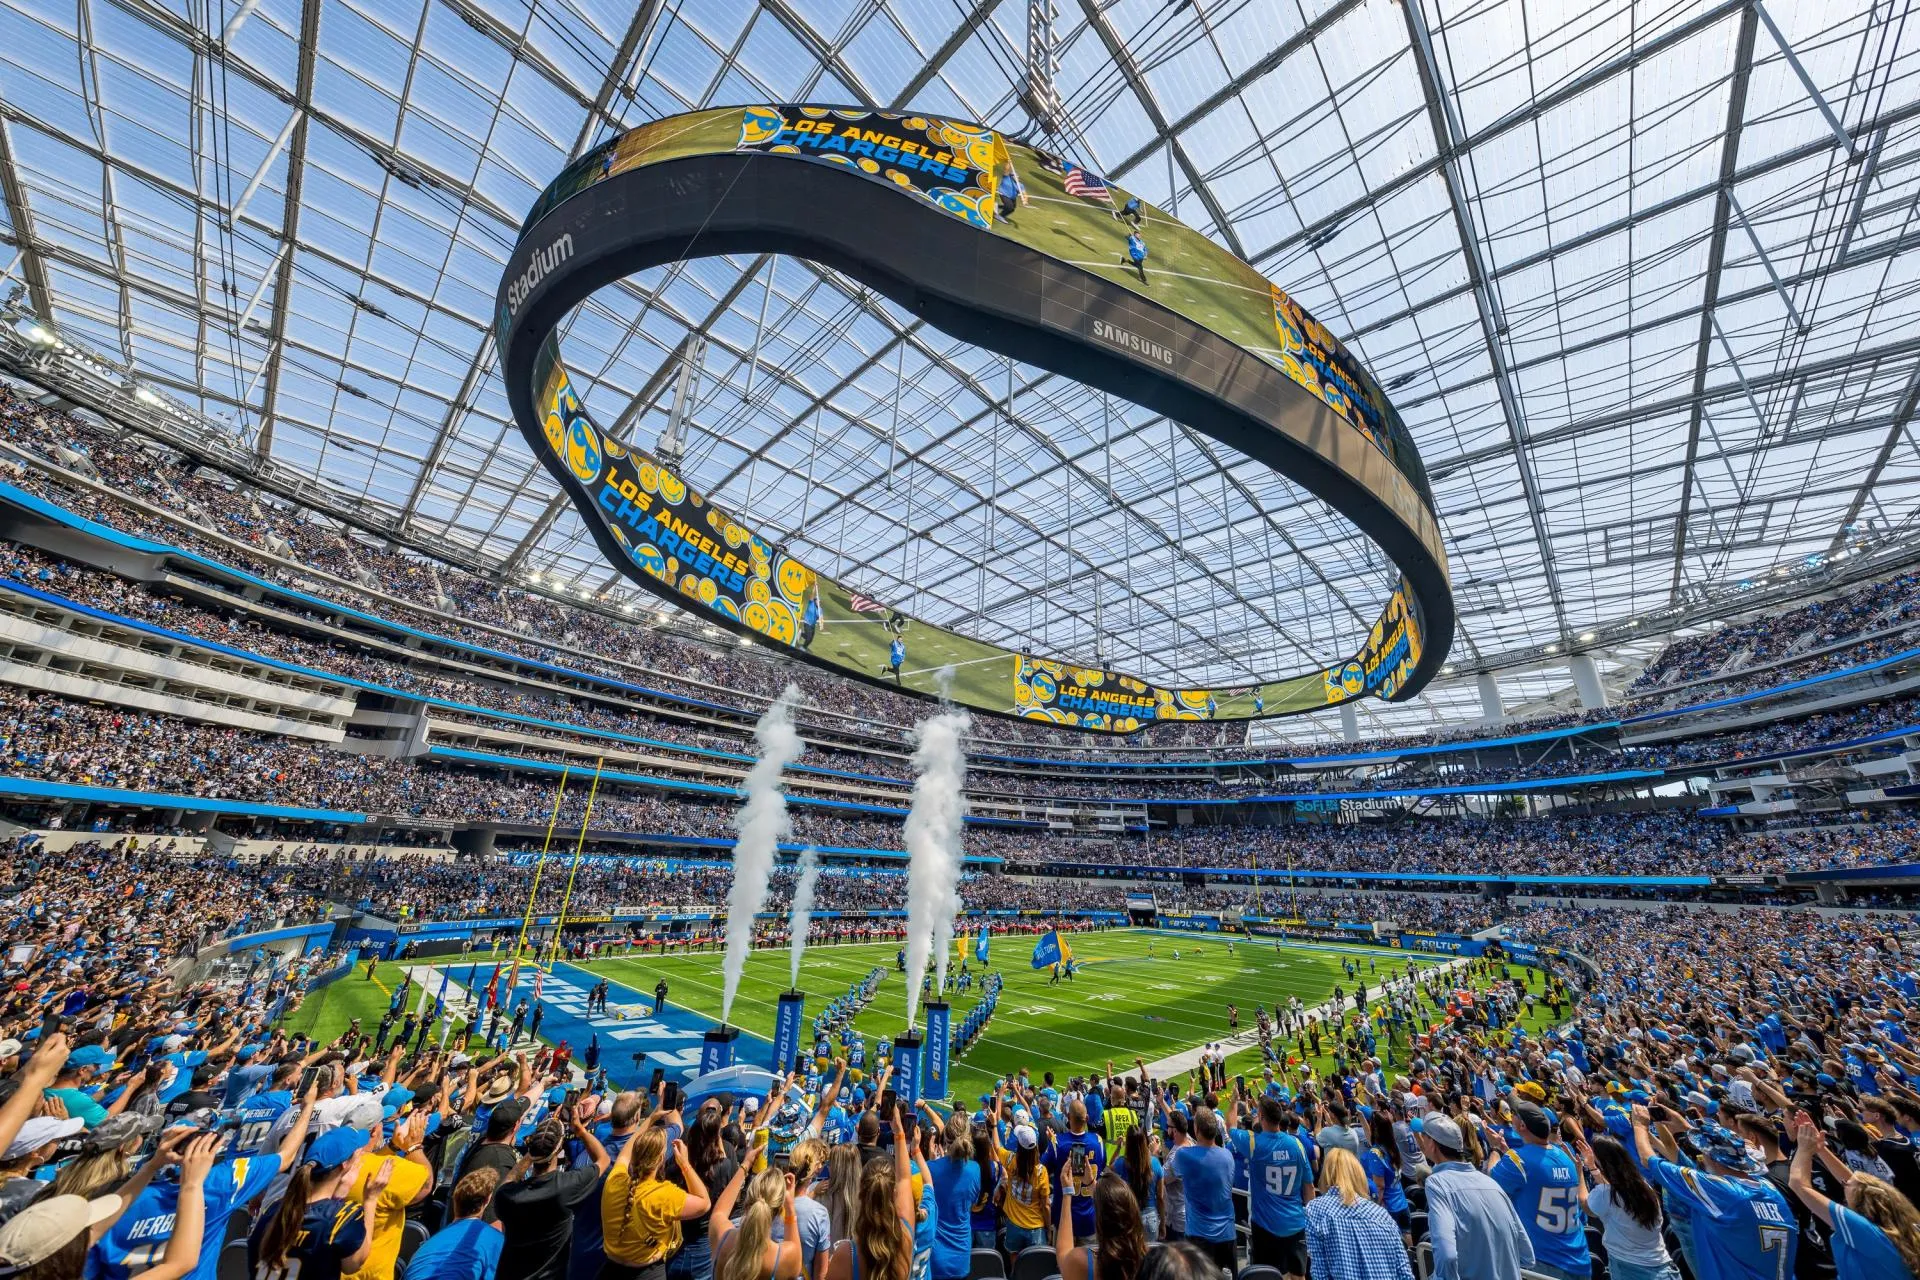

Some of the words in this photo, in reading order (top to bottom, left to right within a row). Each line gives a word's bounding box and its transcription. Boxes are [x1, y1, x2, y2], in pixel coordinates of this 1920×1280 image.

[770, 129, 969, 184] CHARGERS
[782, 118, 836, 134] LOS
[842, 127, 969, 170] ANGELES
[508, 233, 574, 315] Stadium
[1093, 320, 1173, 364] SAMSUNG
[599, 484, 748, 593] CHARGERS
[604, 466, 653, 511] LOS
[655, 508, 749, 576] ANGELES
[1365, 652, 1380, 675] LOS
[1381, 618, 1405, 661] ANGELES
[1366, 631, 1409, 689] CHARGERS
[1058, 694, 1156, 719] CHARGERS
[1060, 684, 1087, 698] LOS
[1090, 690, 1155, 707] ANGELES
[1295, 801, 1325, 812] SoFi
[1340, 799, 1400, 811] Stadium
[900, 1053, 912, 1101] LTUP
[245, 1108, 276, 1119] HERBERT
[1265, 1165, 1298, 1195] 97
[1552, 1167, 1571, 1180] MACK
[127, 1214, 179, 1240] HERB
[1750, 1200, 1785, 1222] VOLEK
[1759, 1225, 1788, 1280] 7
